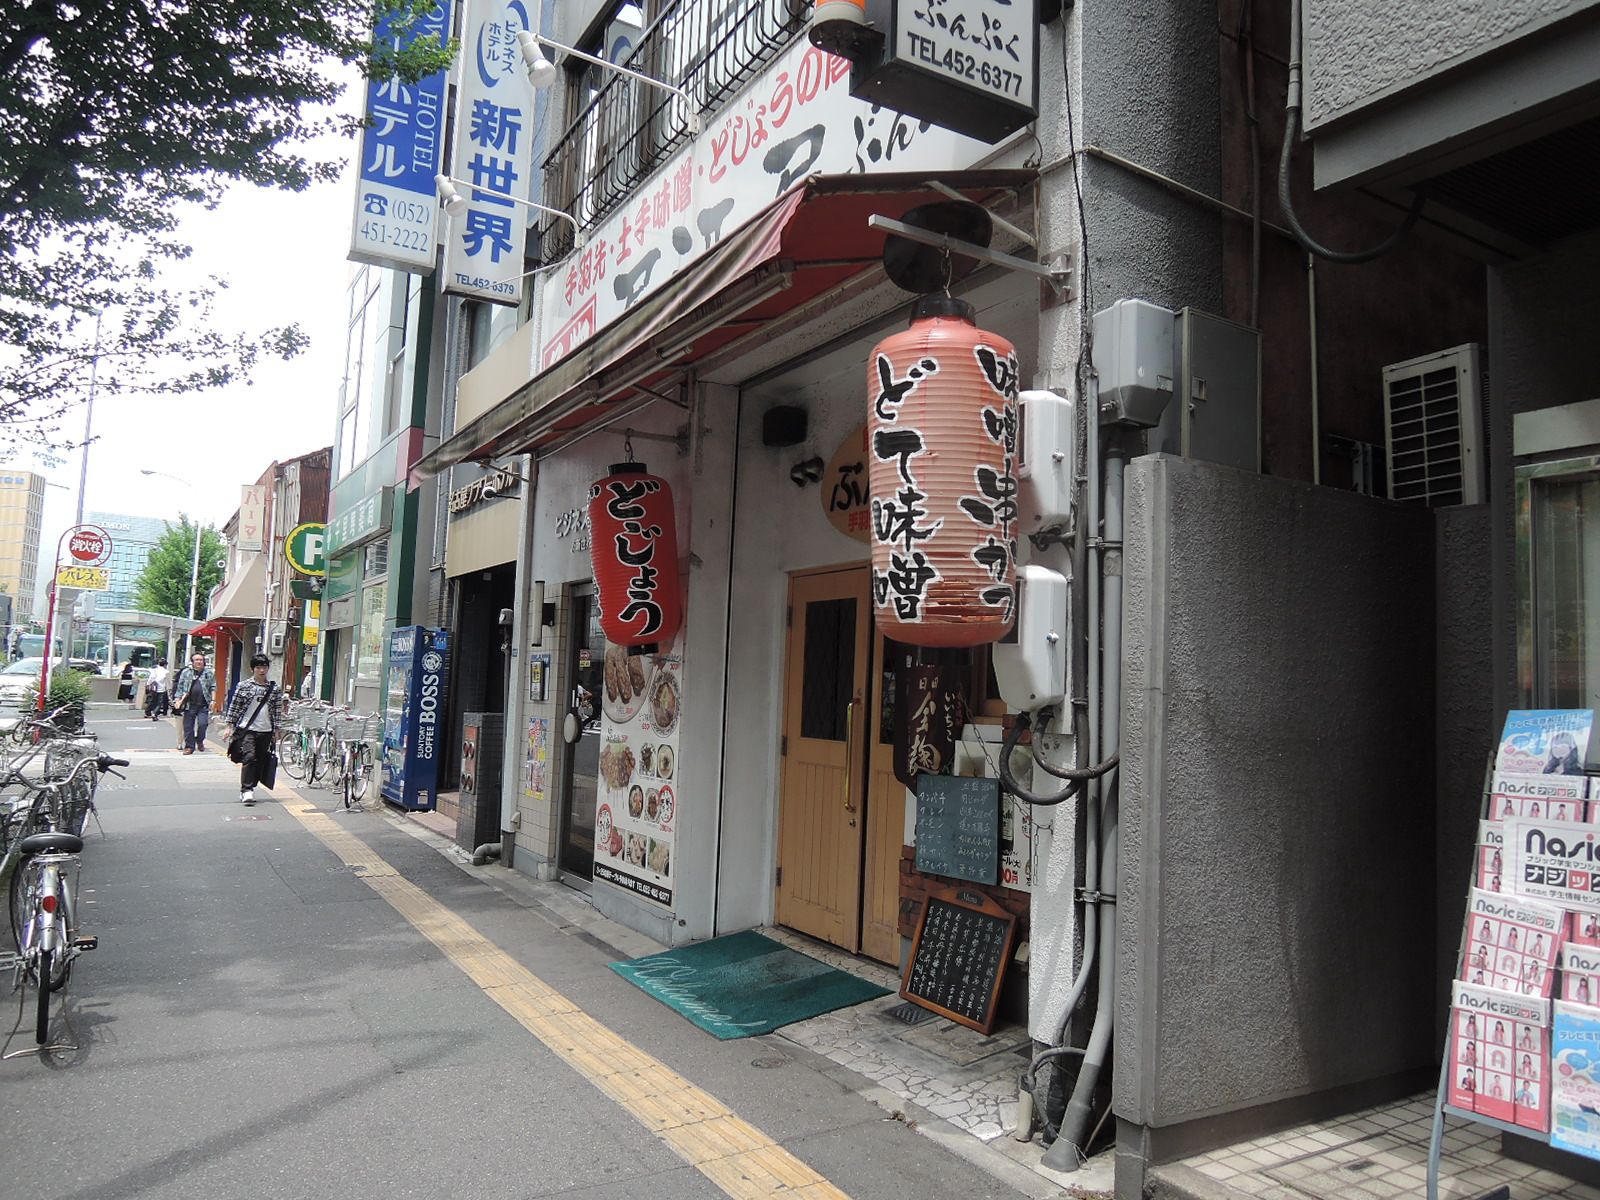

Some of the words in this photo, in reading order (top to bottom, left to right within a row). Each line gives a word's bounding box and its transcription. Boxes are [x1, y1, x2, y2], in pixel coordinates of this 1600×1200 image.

[485, 22, 504, 63] ホテル
[502, 20, 517, 75] ビジネス
[907, 31, 1023, 97] TEL452-6377
[411, 88, 437, 174] HOTEL
[461, 97, 524, 263] 新世界
[361, 219, 429, 253] 451-2222
[391, 201, 430, 226] (052)
[71, 538, 103, 554] 消火栓
[607, 480, 662, 638] どじょう
[419, 674, 439, 724] BOSS
[944, 691, 956, 742] いいちこ
[417, 725, 427, 759] SUNTORY
[424, 726, 435, 759] COFFEE
